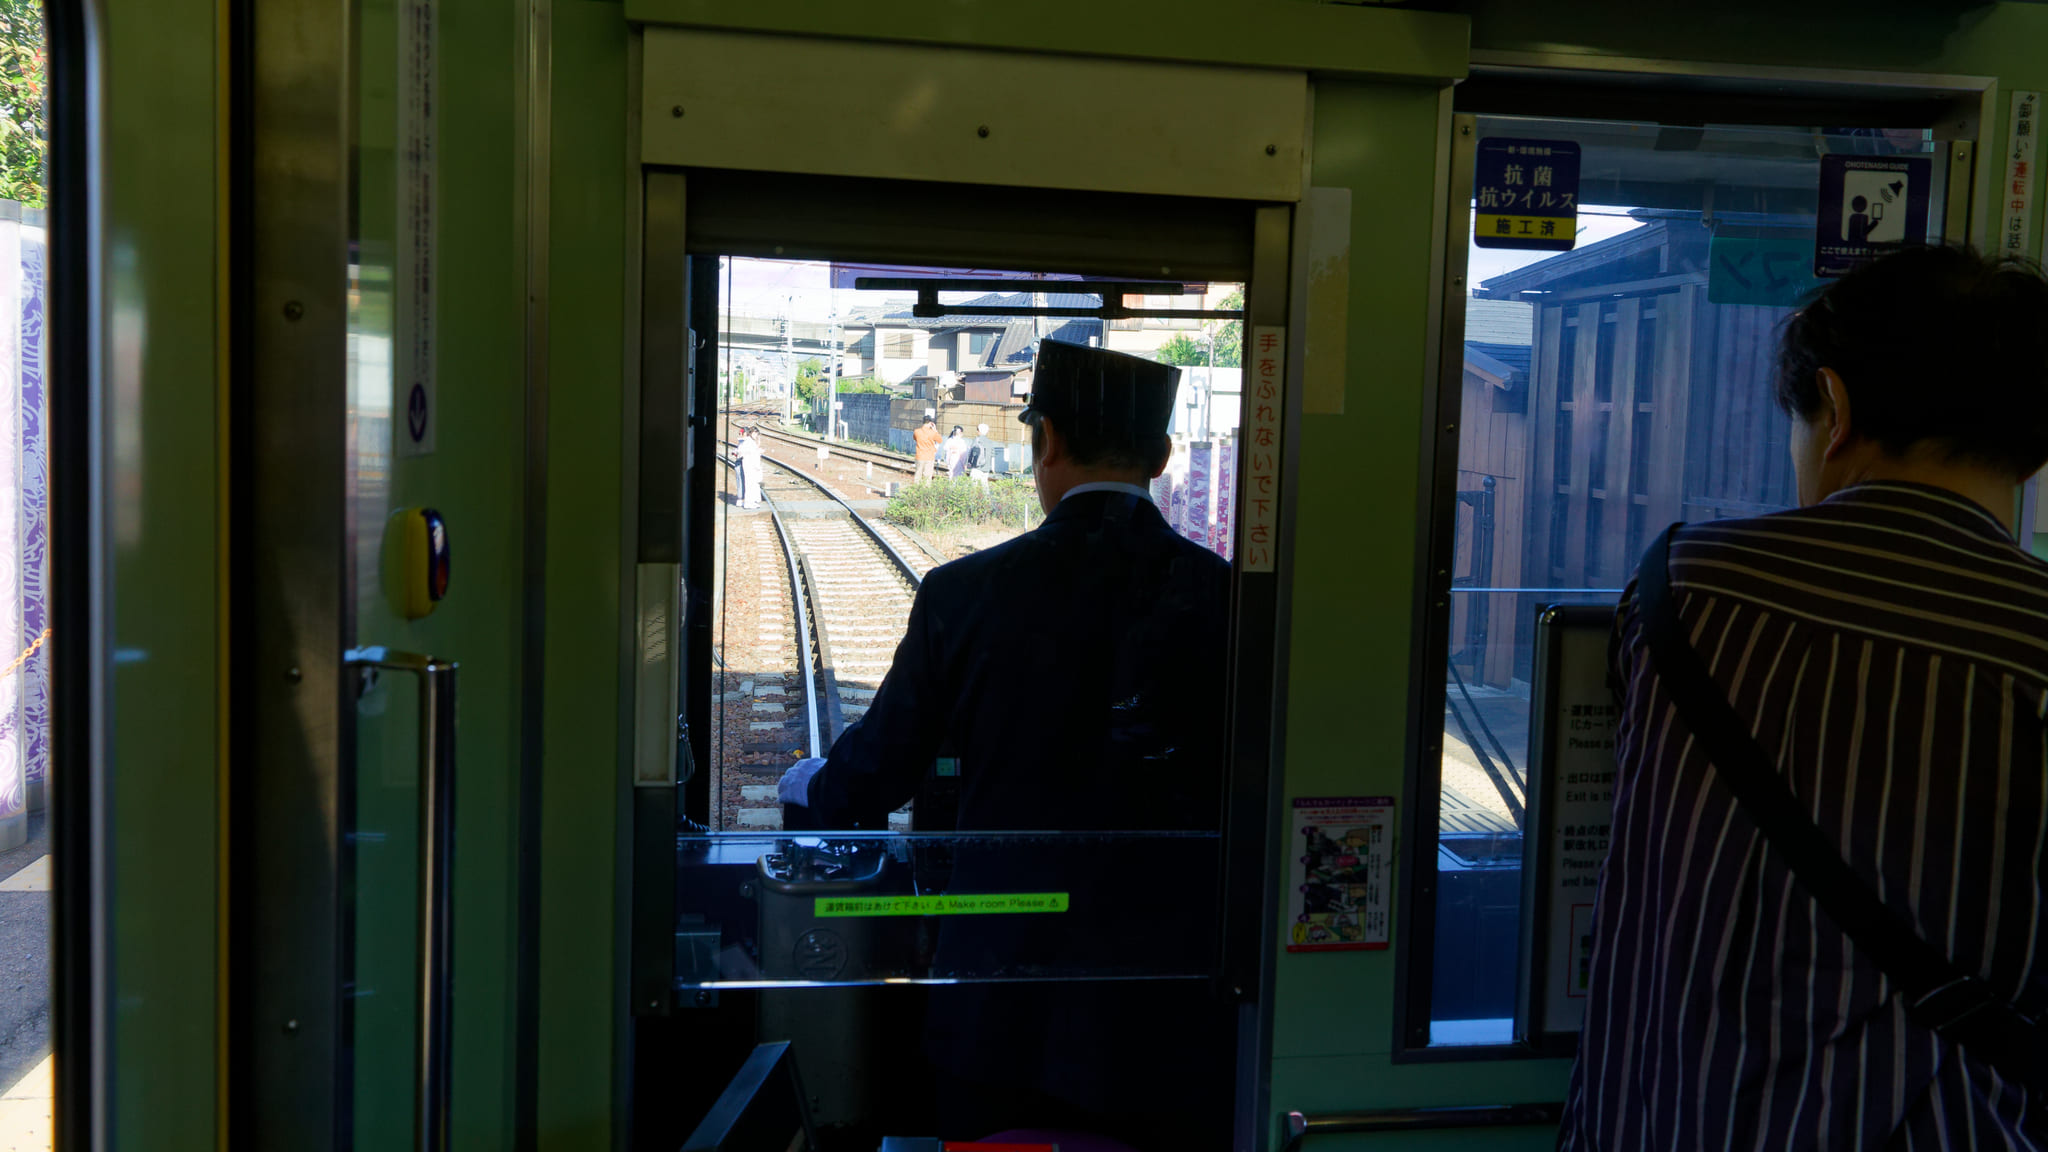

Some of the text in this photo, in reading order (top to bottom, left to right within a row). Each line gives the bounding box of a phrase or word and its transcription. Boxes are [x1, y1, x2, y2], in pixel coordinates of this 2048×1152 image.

[1504, 163, 1553, 187] 抗菌
[1479, 186, 1576, 209] 抗ウイルス
[1495, 217, 1556, 237] 施工済
[1249, 333, 1278, 566] 手をふれないで下さい
[1568, 737, 1601, 749] Please
[1566, 791, 1586, 802] Exit
[1589, 791, 1599, 801] is
[1562, 858, 1594, 869] Please
[949, 897, 1045, 910] Make room Please
